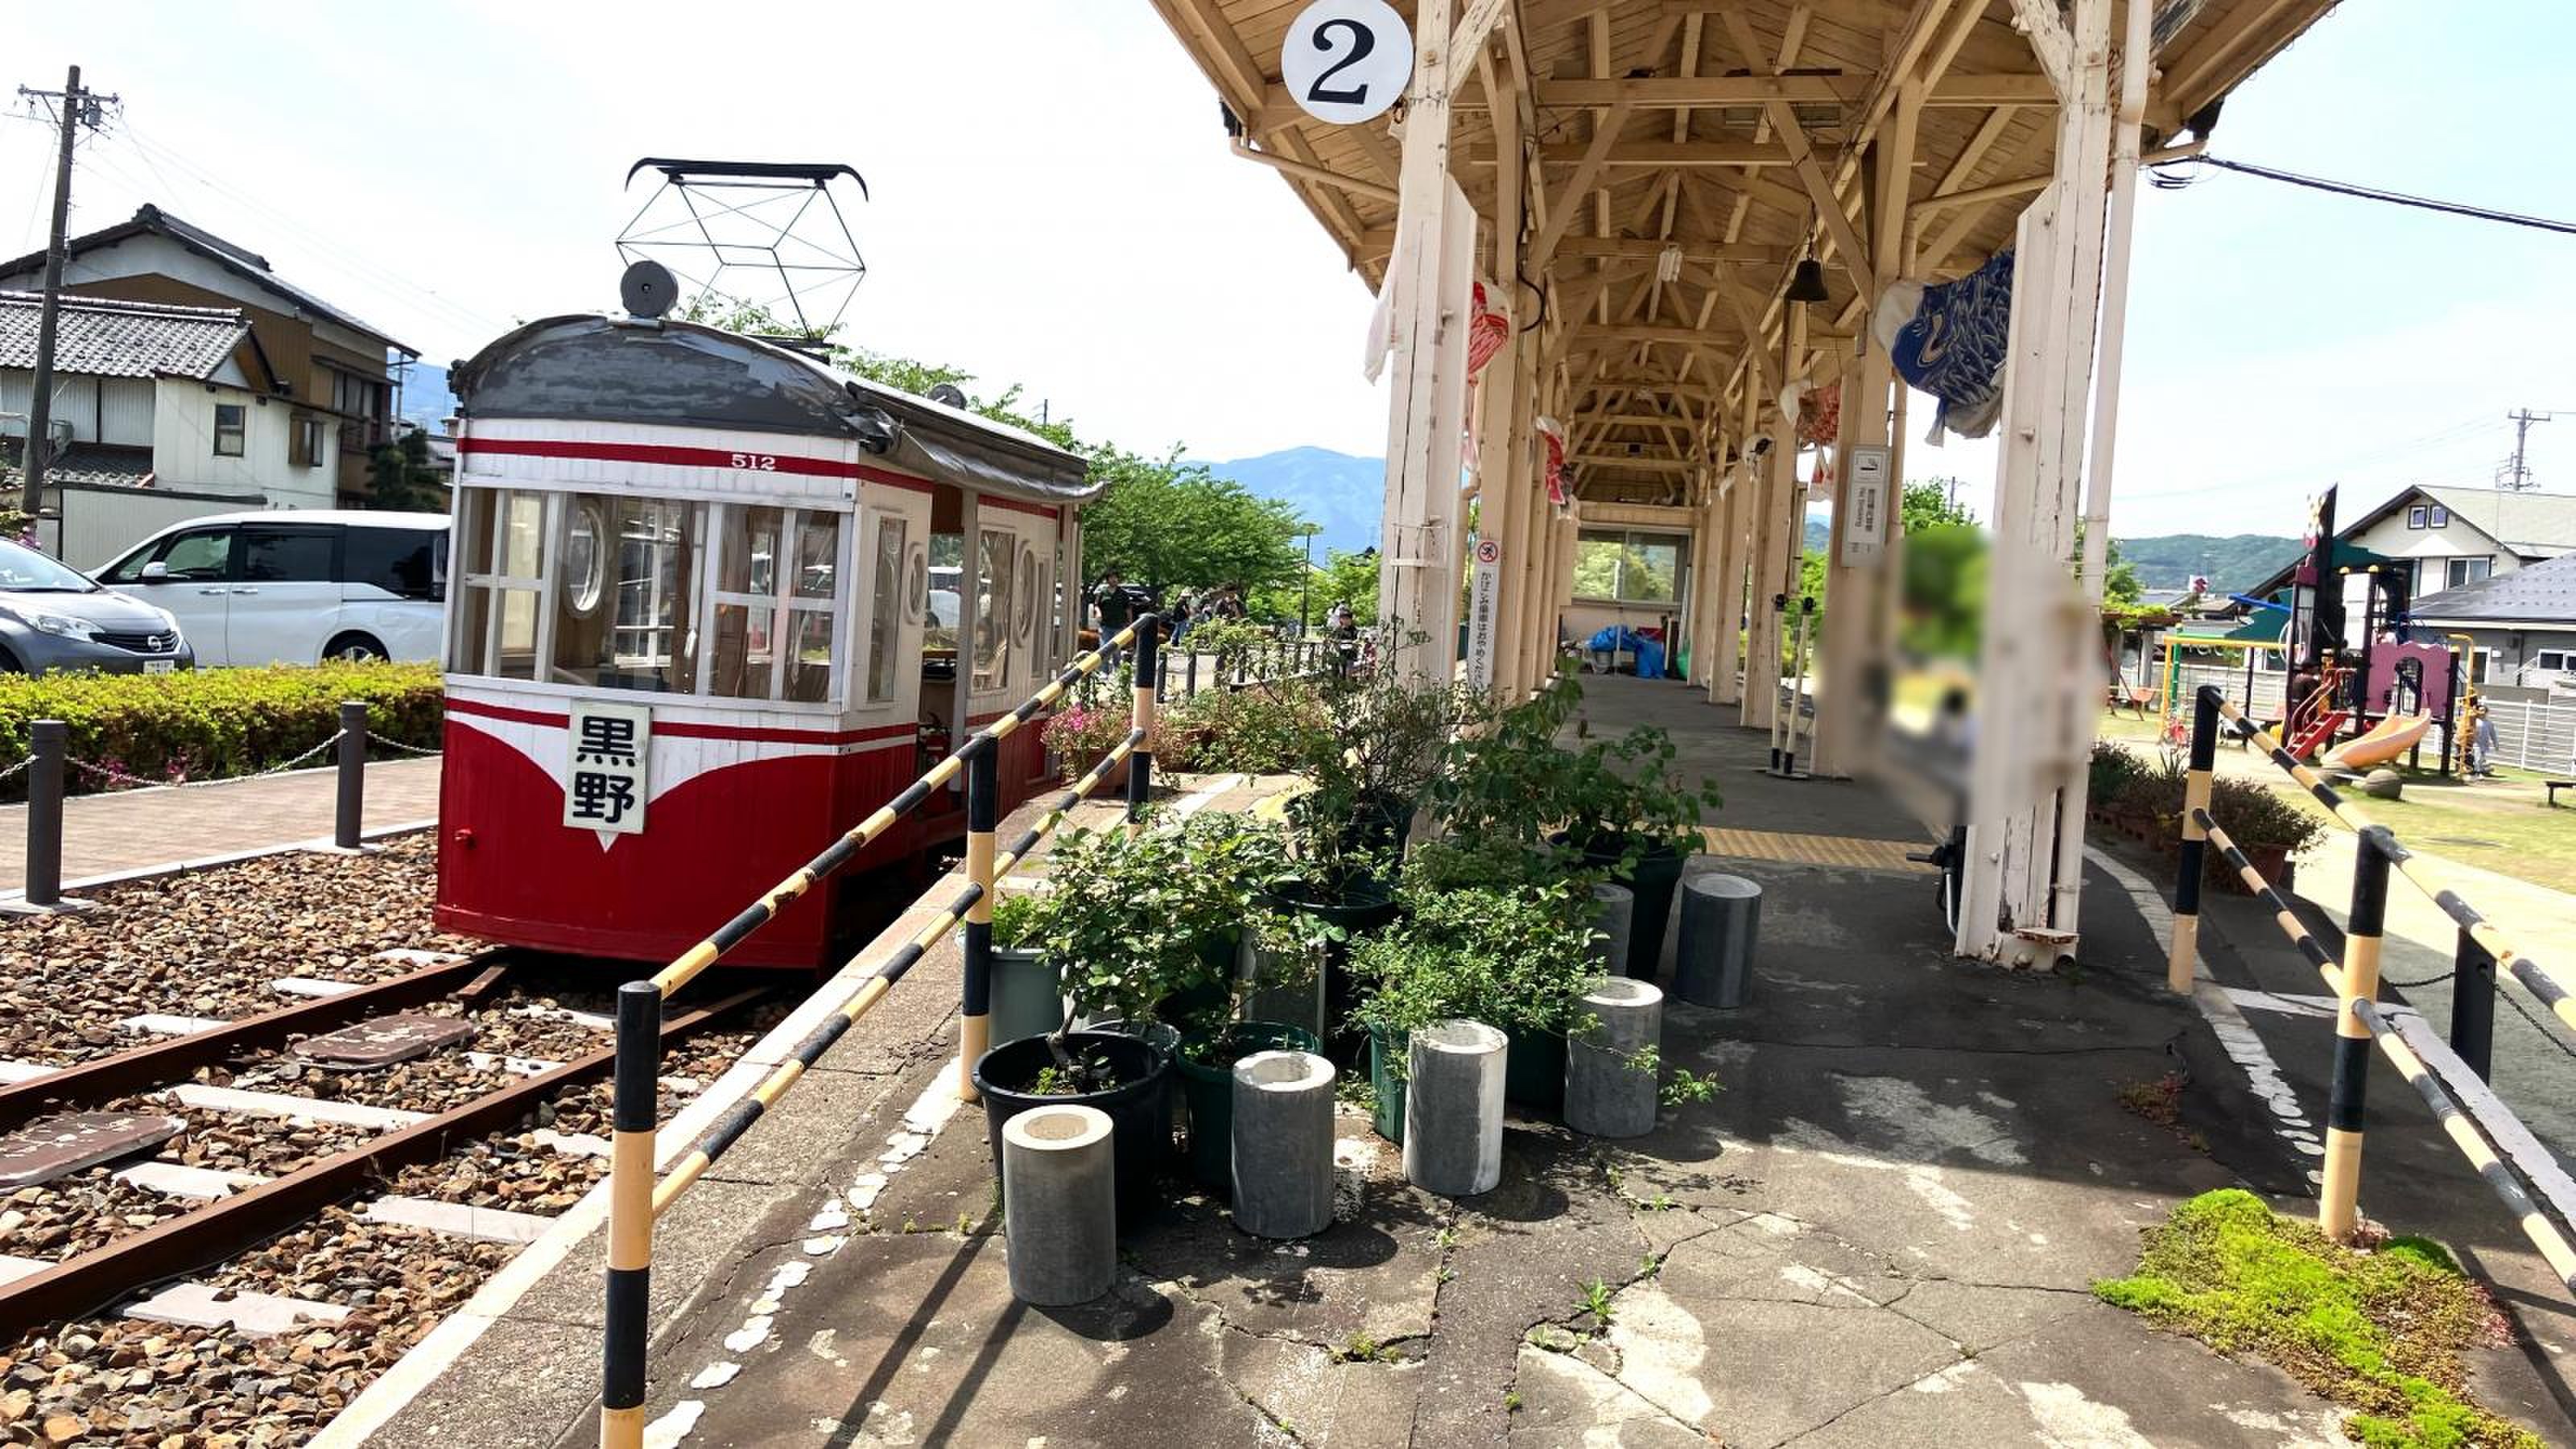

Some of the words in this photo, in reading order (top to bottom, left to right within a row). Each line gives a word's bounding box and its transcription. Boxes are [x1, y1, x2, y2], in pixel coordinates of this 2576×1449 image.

[1307, 19, 1375, 105] 2
[732, 453, 776, 470] 512
[572, 716, 636, 823] 黒野
